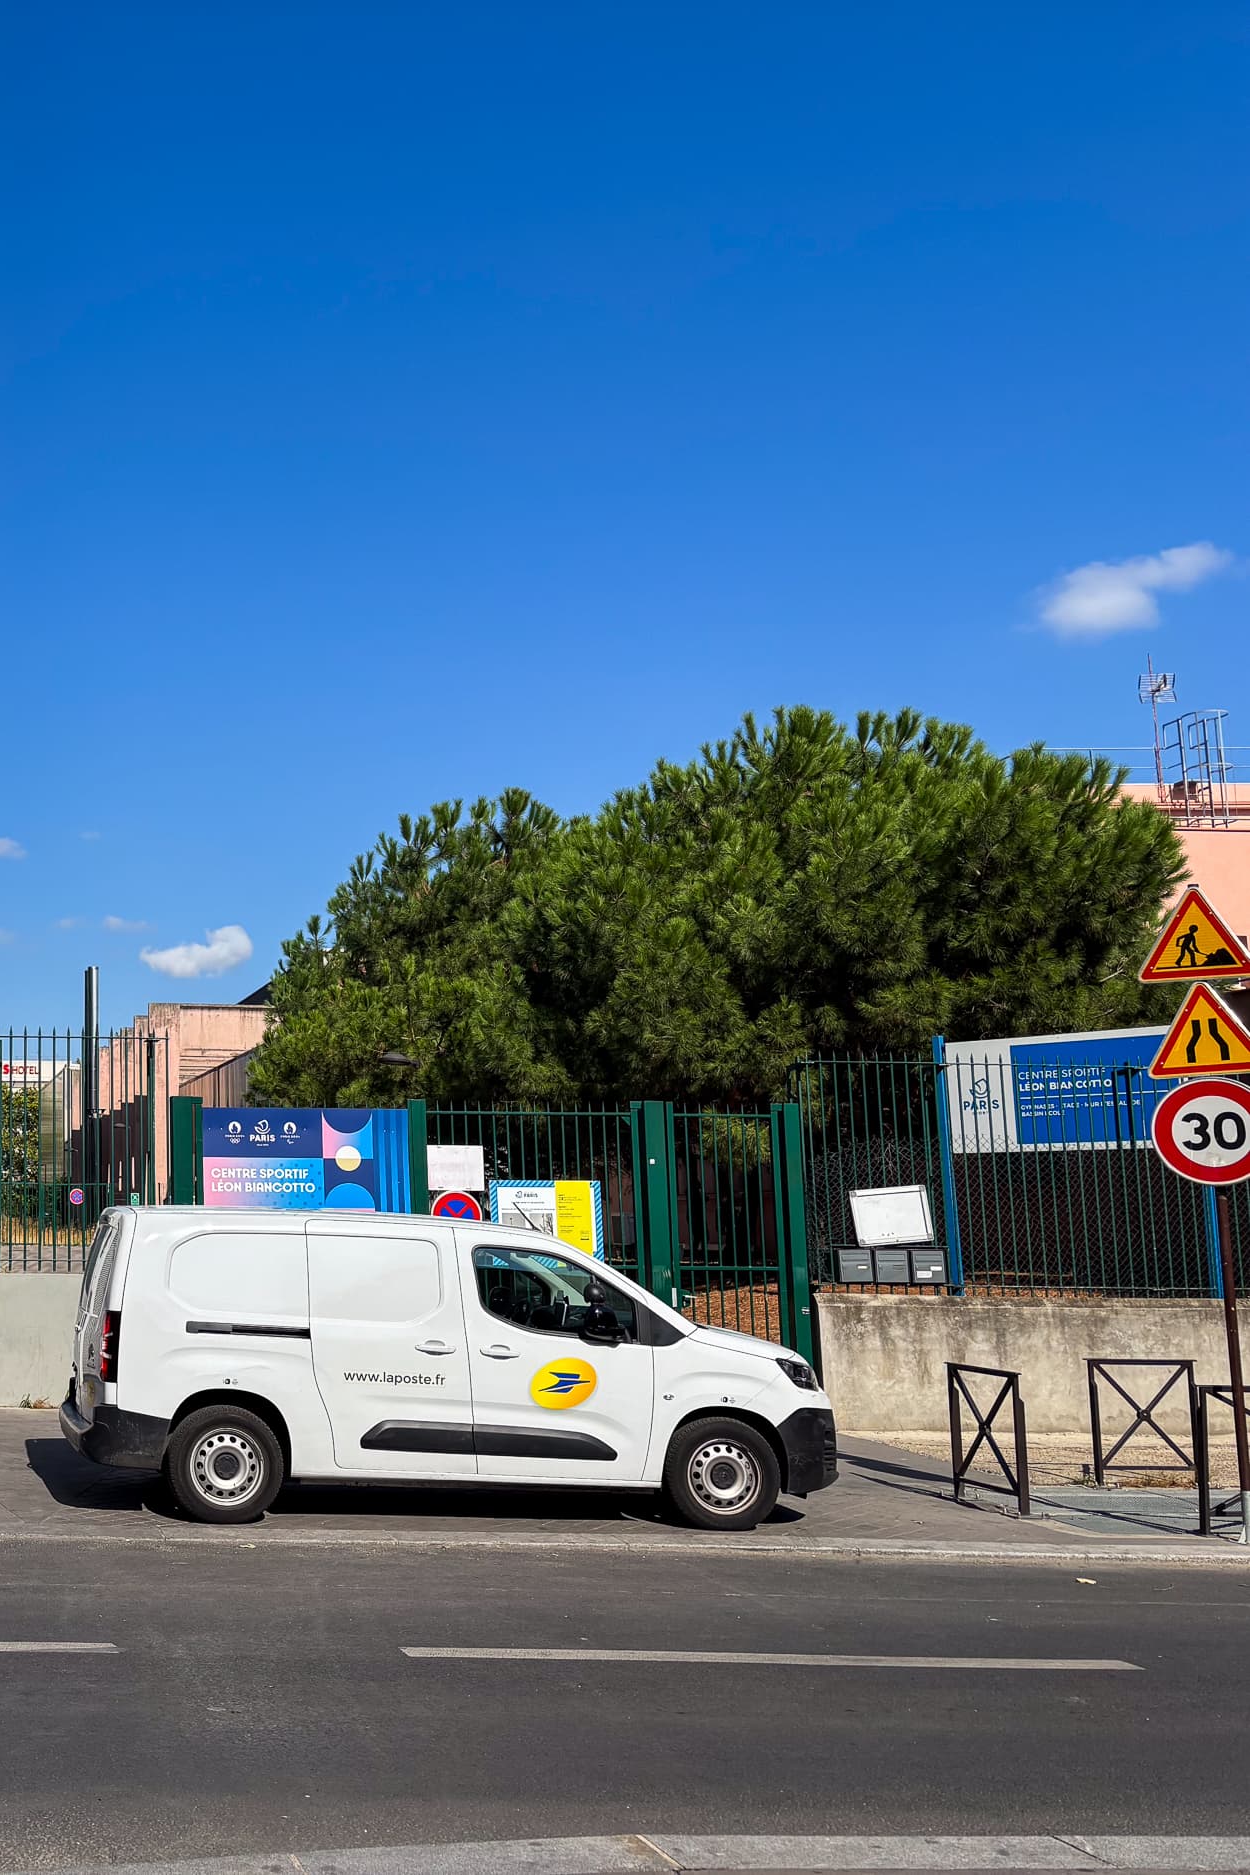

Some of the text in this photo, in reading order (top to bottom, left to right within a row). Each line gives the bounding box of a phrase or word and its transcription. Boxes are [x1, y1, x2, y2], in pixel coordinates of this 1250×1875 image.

[1018, 1070, 1058, 1080] CENTRE
[963, 1099, 1000, 1111] PARS
[1181, 1111, 1247, 1151] 30
[249, 1134, 276, 1142] PARIS
[211, 1168, 309, 1179] CENTRE SPORTIF
[211, 1179, 316, 1193] LÉON BIANCOTTO
[343, 1371, 446, 1386] www.laposte.fr
